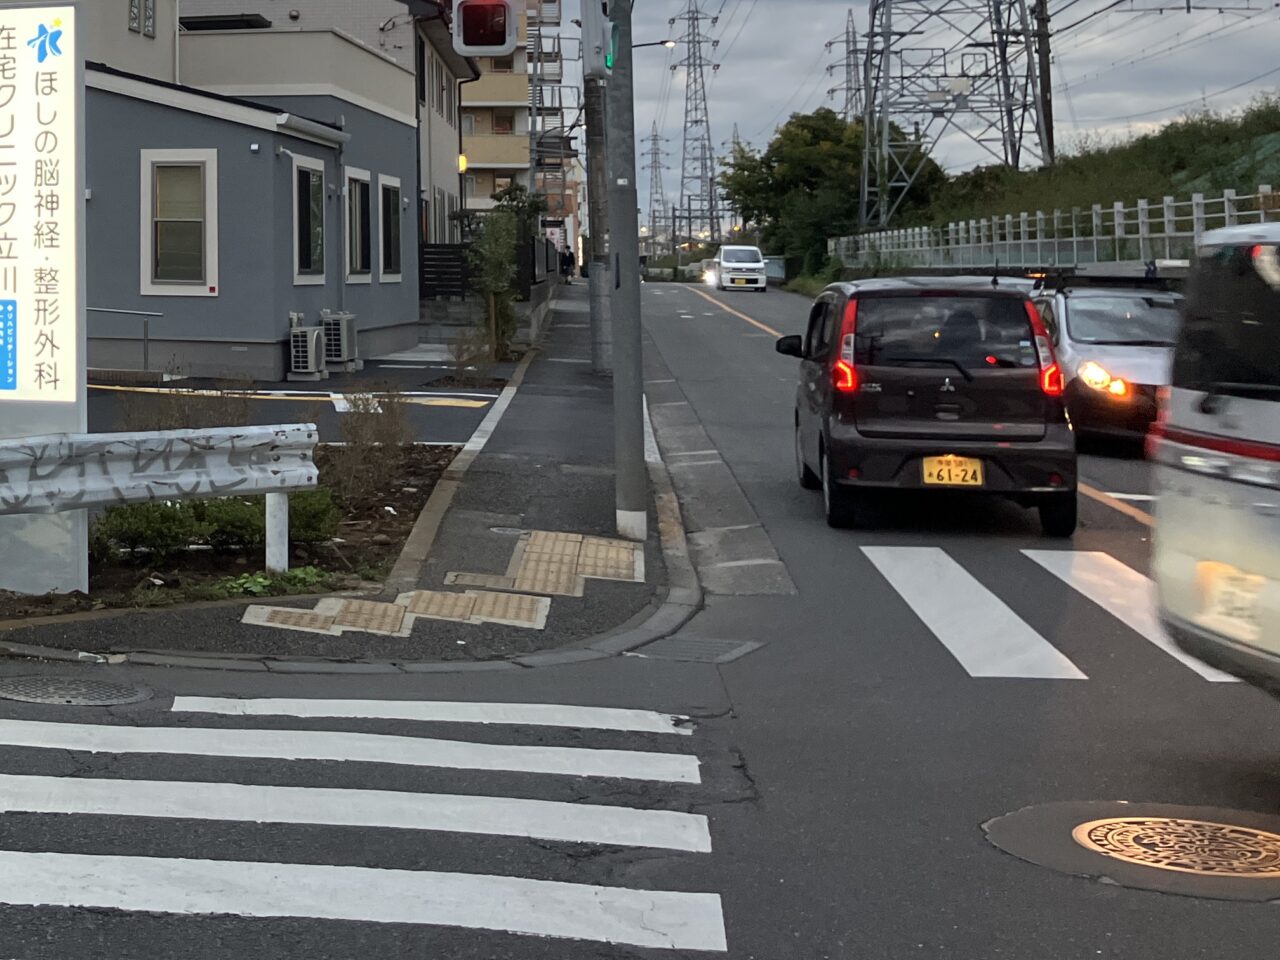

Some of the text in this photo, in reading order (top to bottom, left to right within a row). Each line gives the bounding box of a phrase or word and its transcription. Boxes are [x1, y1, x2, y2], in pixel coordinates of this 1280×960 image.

[33, 70, 60, 391] ほしの脳神経・整形外科
[936, 468, 978, 483] 61-24
